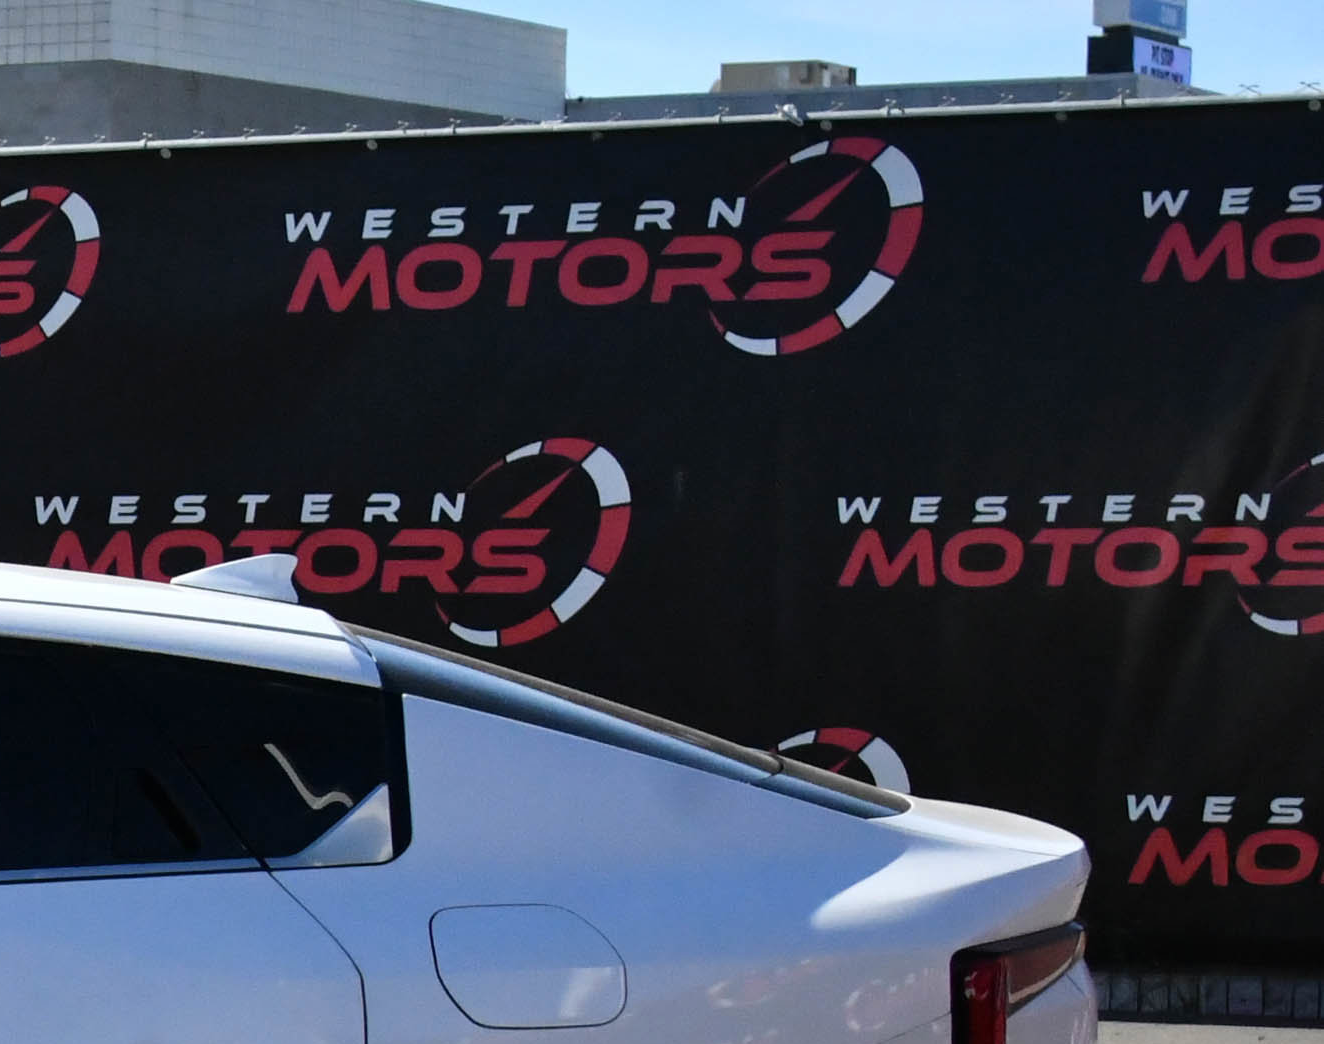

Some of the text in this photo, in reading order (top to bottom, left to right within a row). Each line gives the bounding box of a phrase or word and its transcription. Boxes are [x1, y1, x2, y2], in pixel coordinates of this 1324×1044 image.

[285, 197, 746, 243] WESTERN
[287, 232, 834, 313] MOTORS
[35, 492, 466, 525] WESTERN
[837, 493, 1271, 524] WESTERN
[1128, 827, 1324, 886] MO
